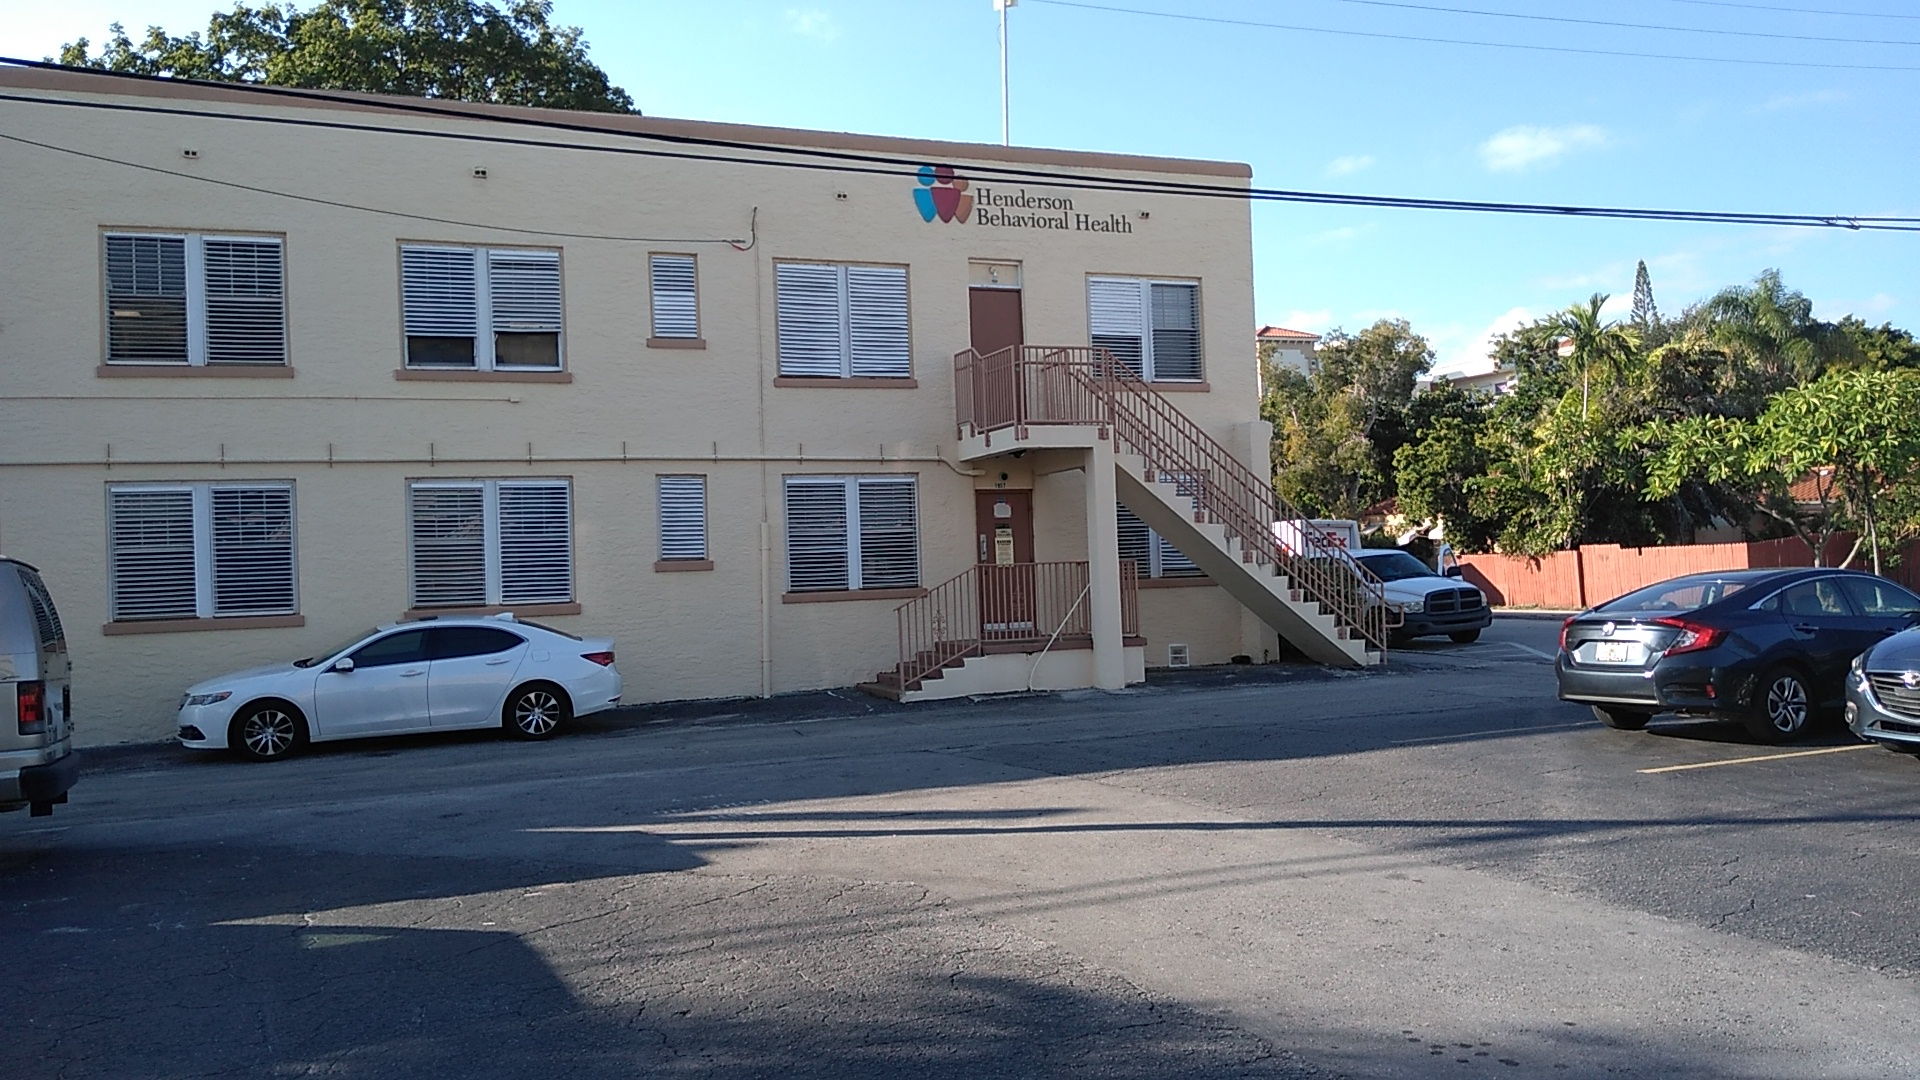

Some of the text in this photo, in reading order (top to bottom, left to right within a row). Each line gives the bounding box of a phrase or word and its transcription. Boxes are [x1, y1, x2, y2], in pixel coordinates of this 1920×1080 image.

[976, 188, 1074, 210] Henderson
[976, 207, 1133, 233] Behavioral Health
[1305, 531, 1348, 548] FedEx
